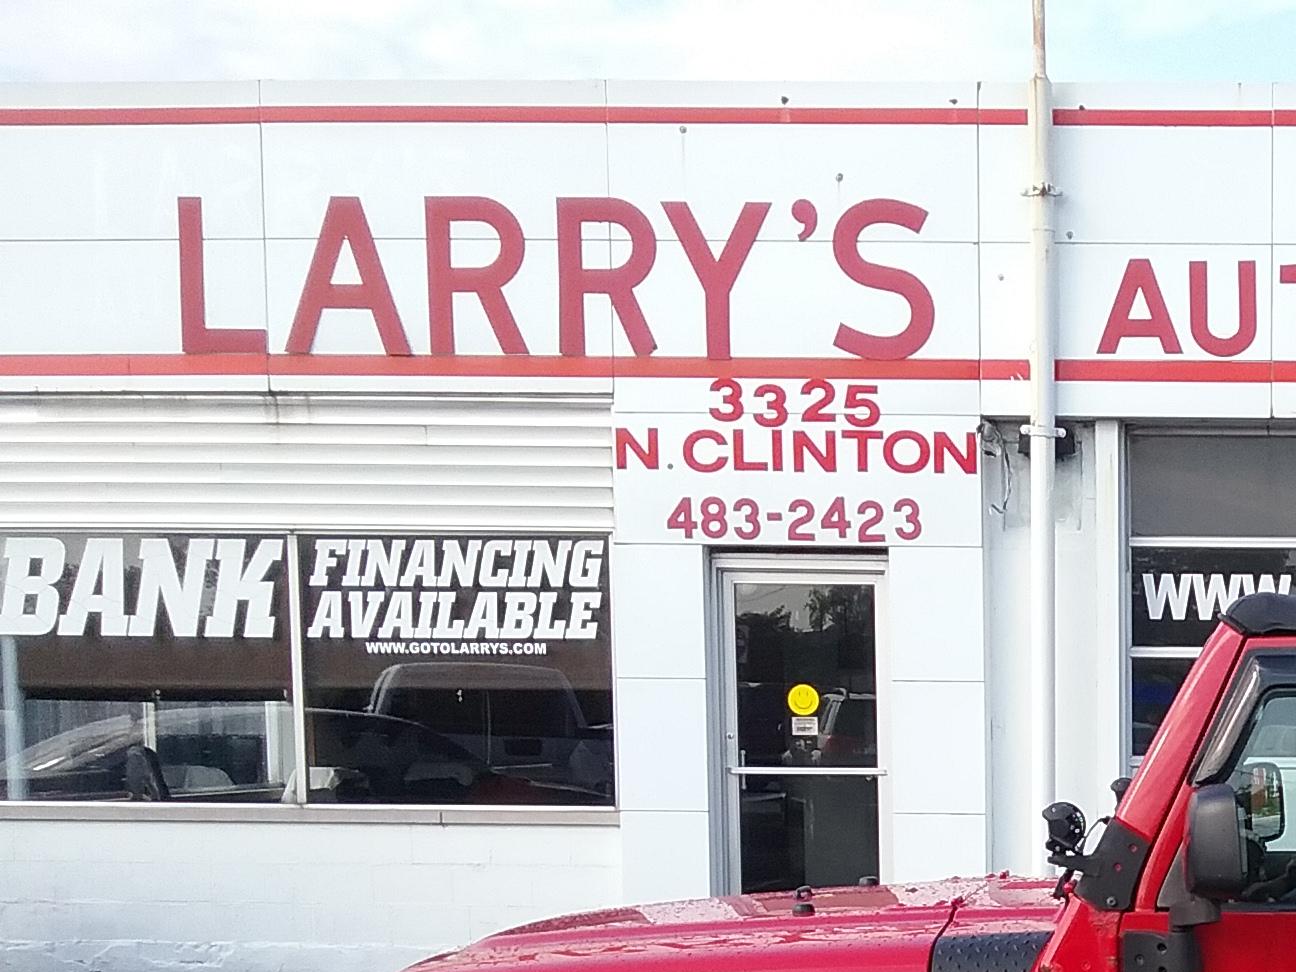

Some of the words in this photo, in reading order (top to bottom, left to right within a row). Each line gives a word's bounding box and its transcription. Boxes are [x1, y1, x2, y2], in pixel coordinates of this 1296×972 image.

[177, 196, 936, 361] LARRY'S
[708, 378, 881, 428] 3325
[666, 496, 923, 543] 483-2423
[0, 537, 284, 638] BANK
[309, 539, 604, 588] FINANCING
[307, 590, 602, 639] AVAILABLE
[365, 641, 547, 656] WWW.GOTOLARRYS.COM
